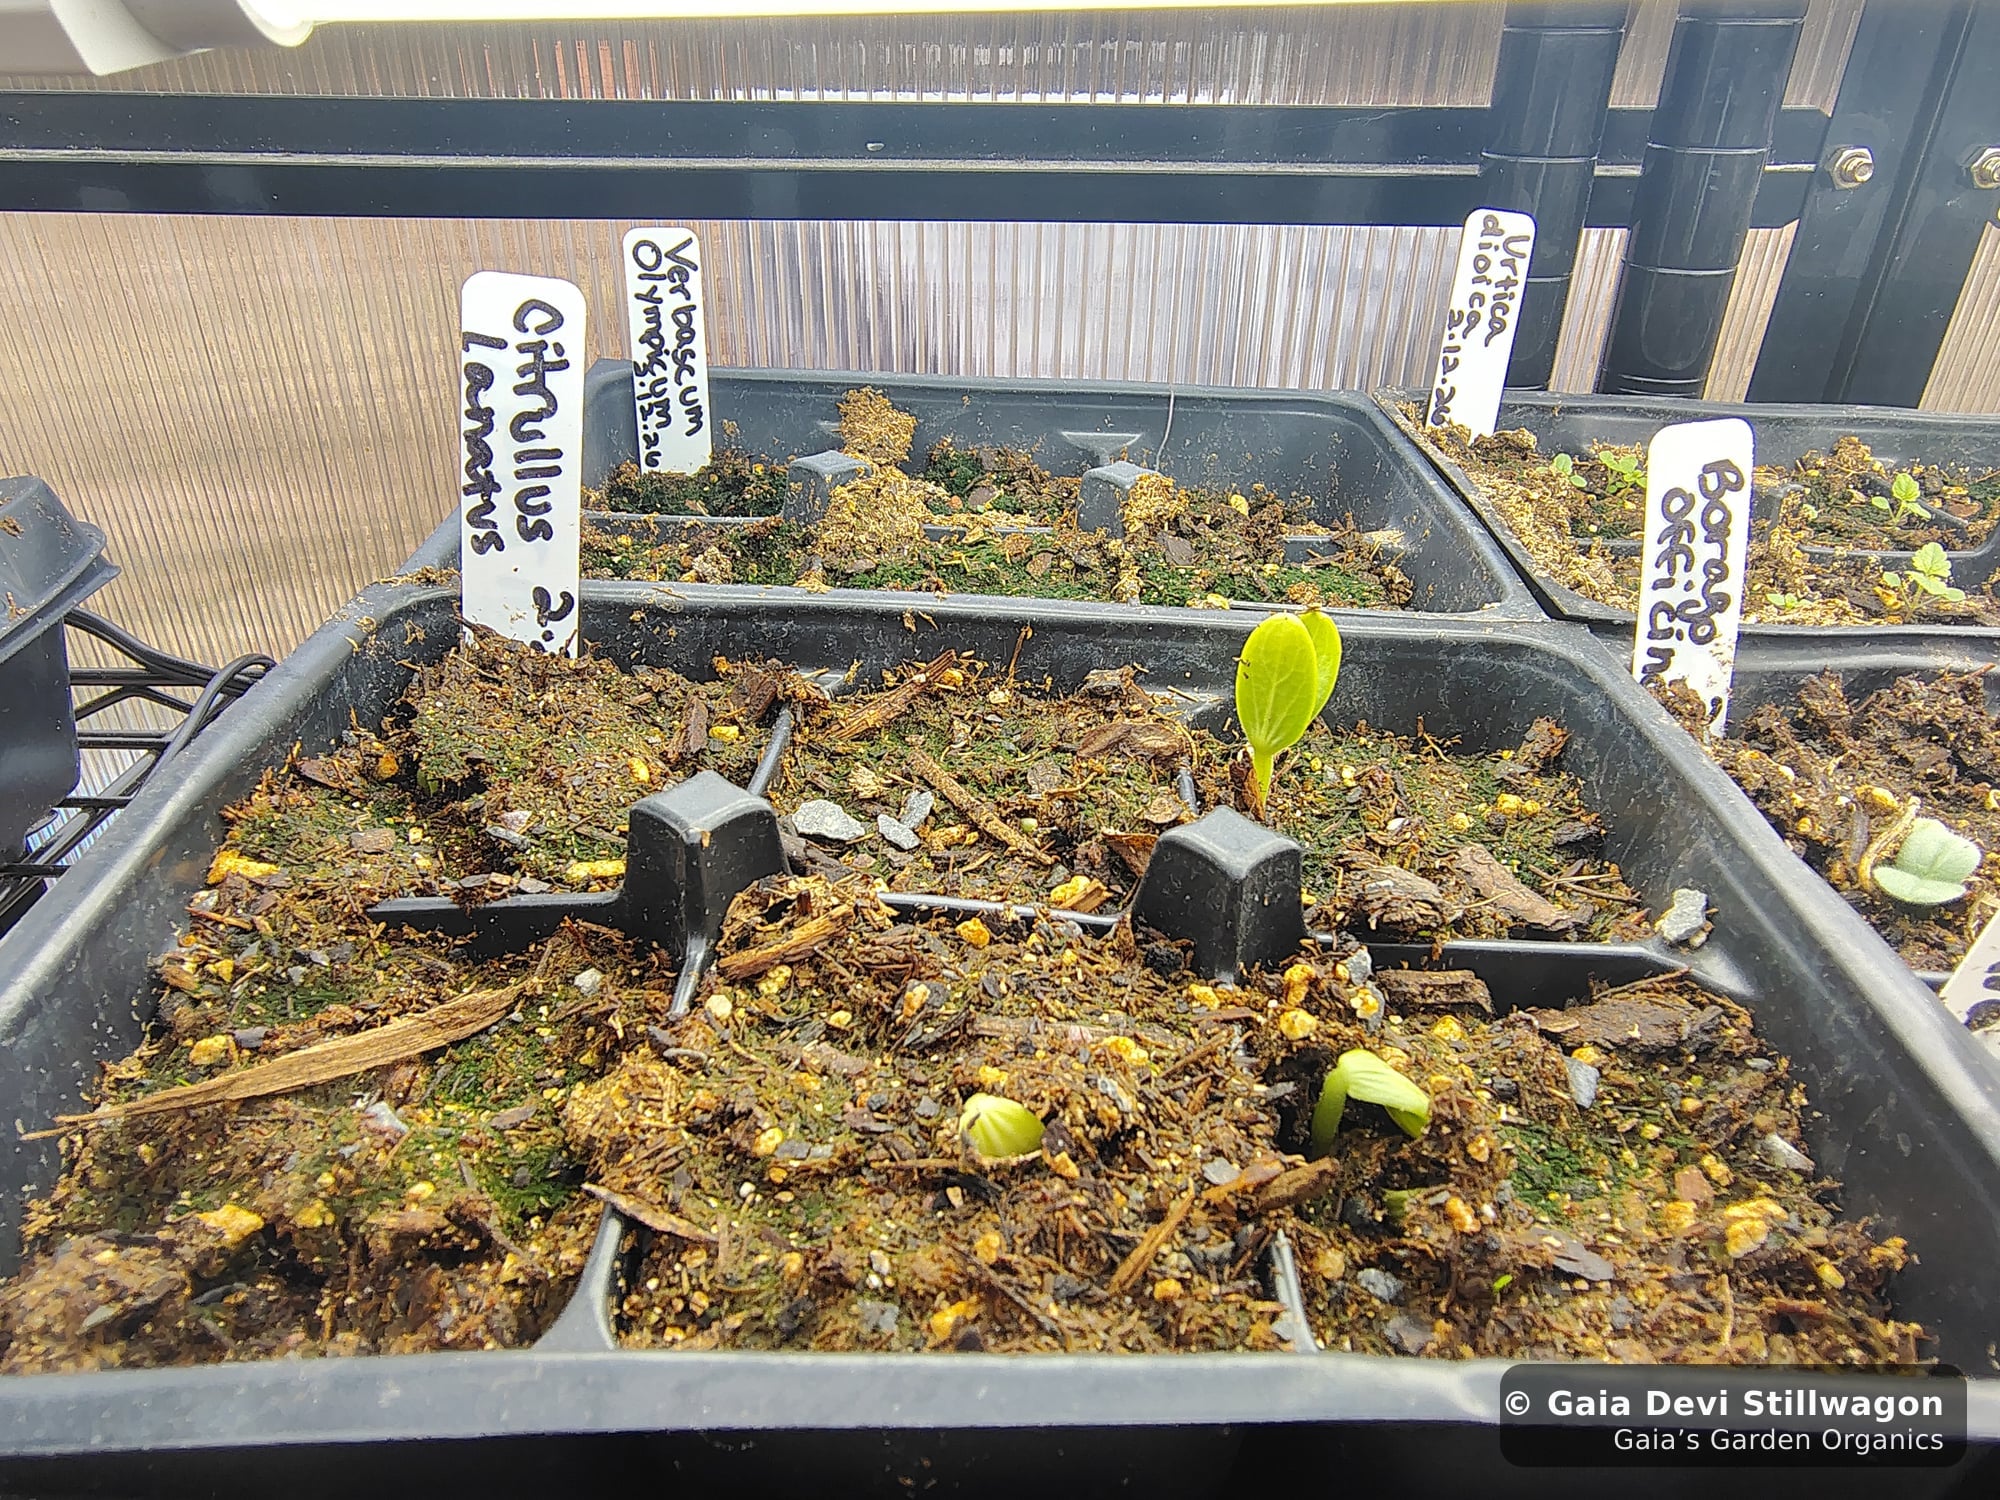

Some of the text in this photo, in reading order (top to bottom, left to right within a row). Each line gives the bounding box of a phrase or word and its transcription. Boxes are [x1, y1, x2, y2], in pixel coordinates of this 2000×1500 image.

[664, 237, 703, 437] Verbascum
[1484, 235, 1531, 348] Urtica
[509, 298, 570, 542] Citrullus
[1676, 458, 1745, 646] Borago
